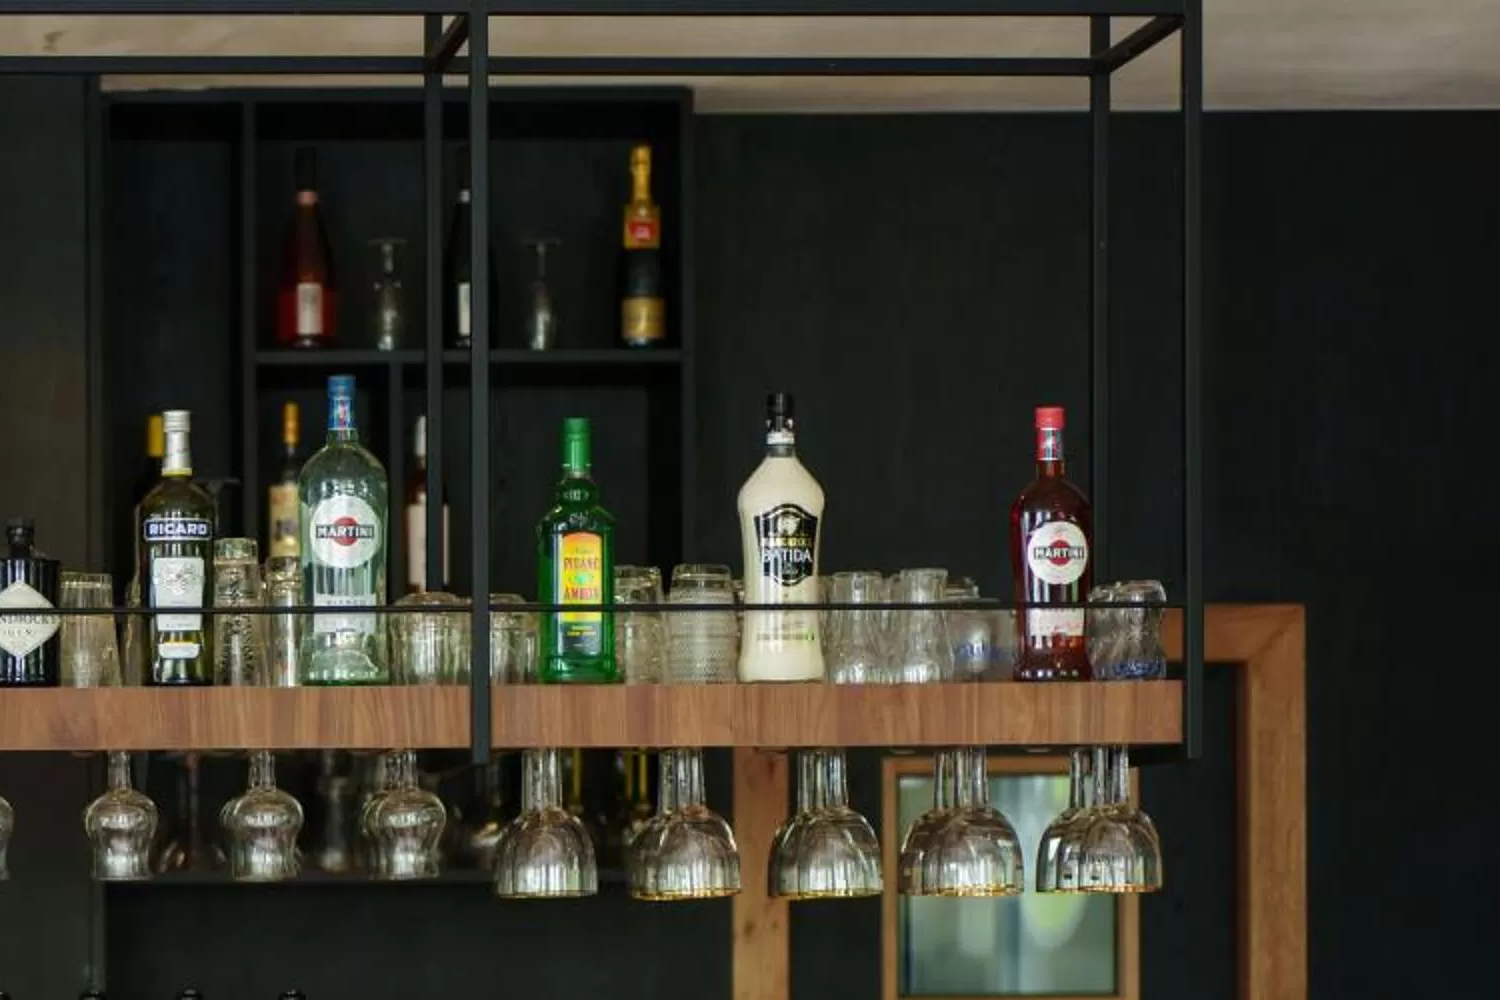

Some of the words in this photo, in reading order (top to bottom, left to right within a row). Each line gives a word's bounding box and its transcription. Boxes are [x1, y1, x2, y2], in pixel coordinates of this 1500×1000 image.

[149, 523, 207, 535] RICARD
[317, 526, 373, 538] MARTINI
[1035, 547, 1084, 559] MARTINI
